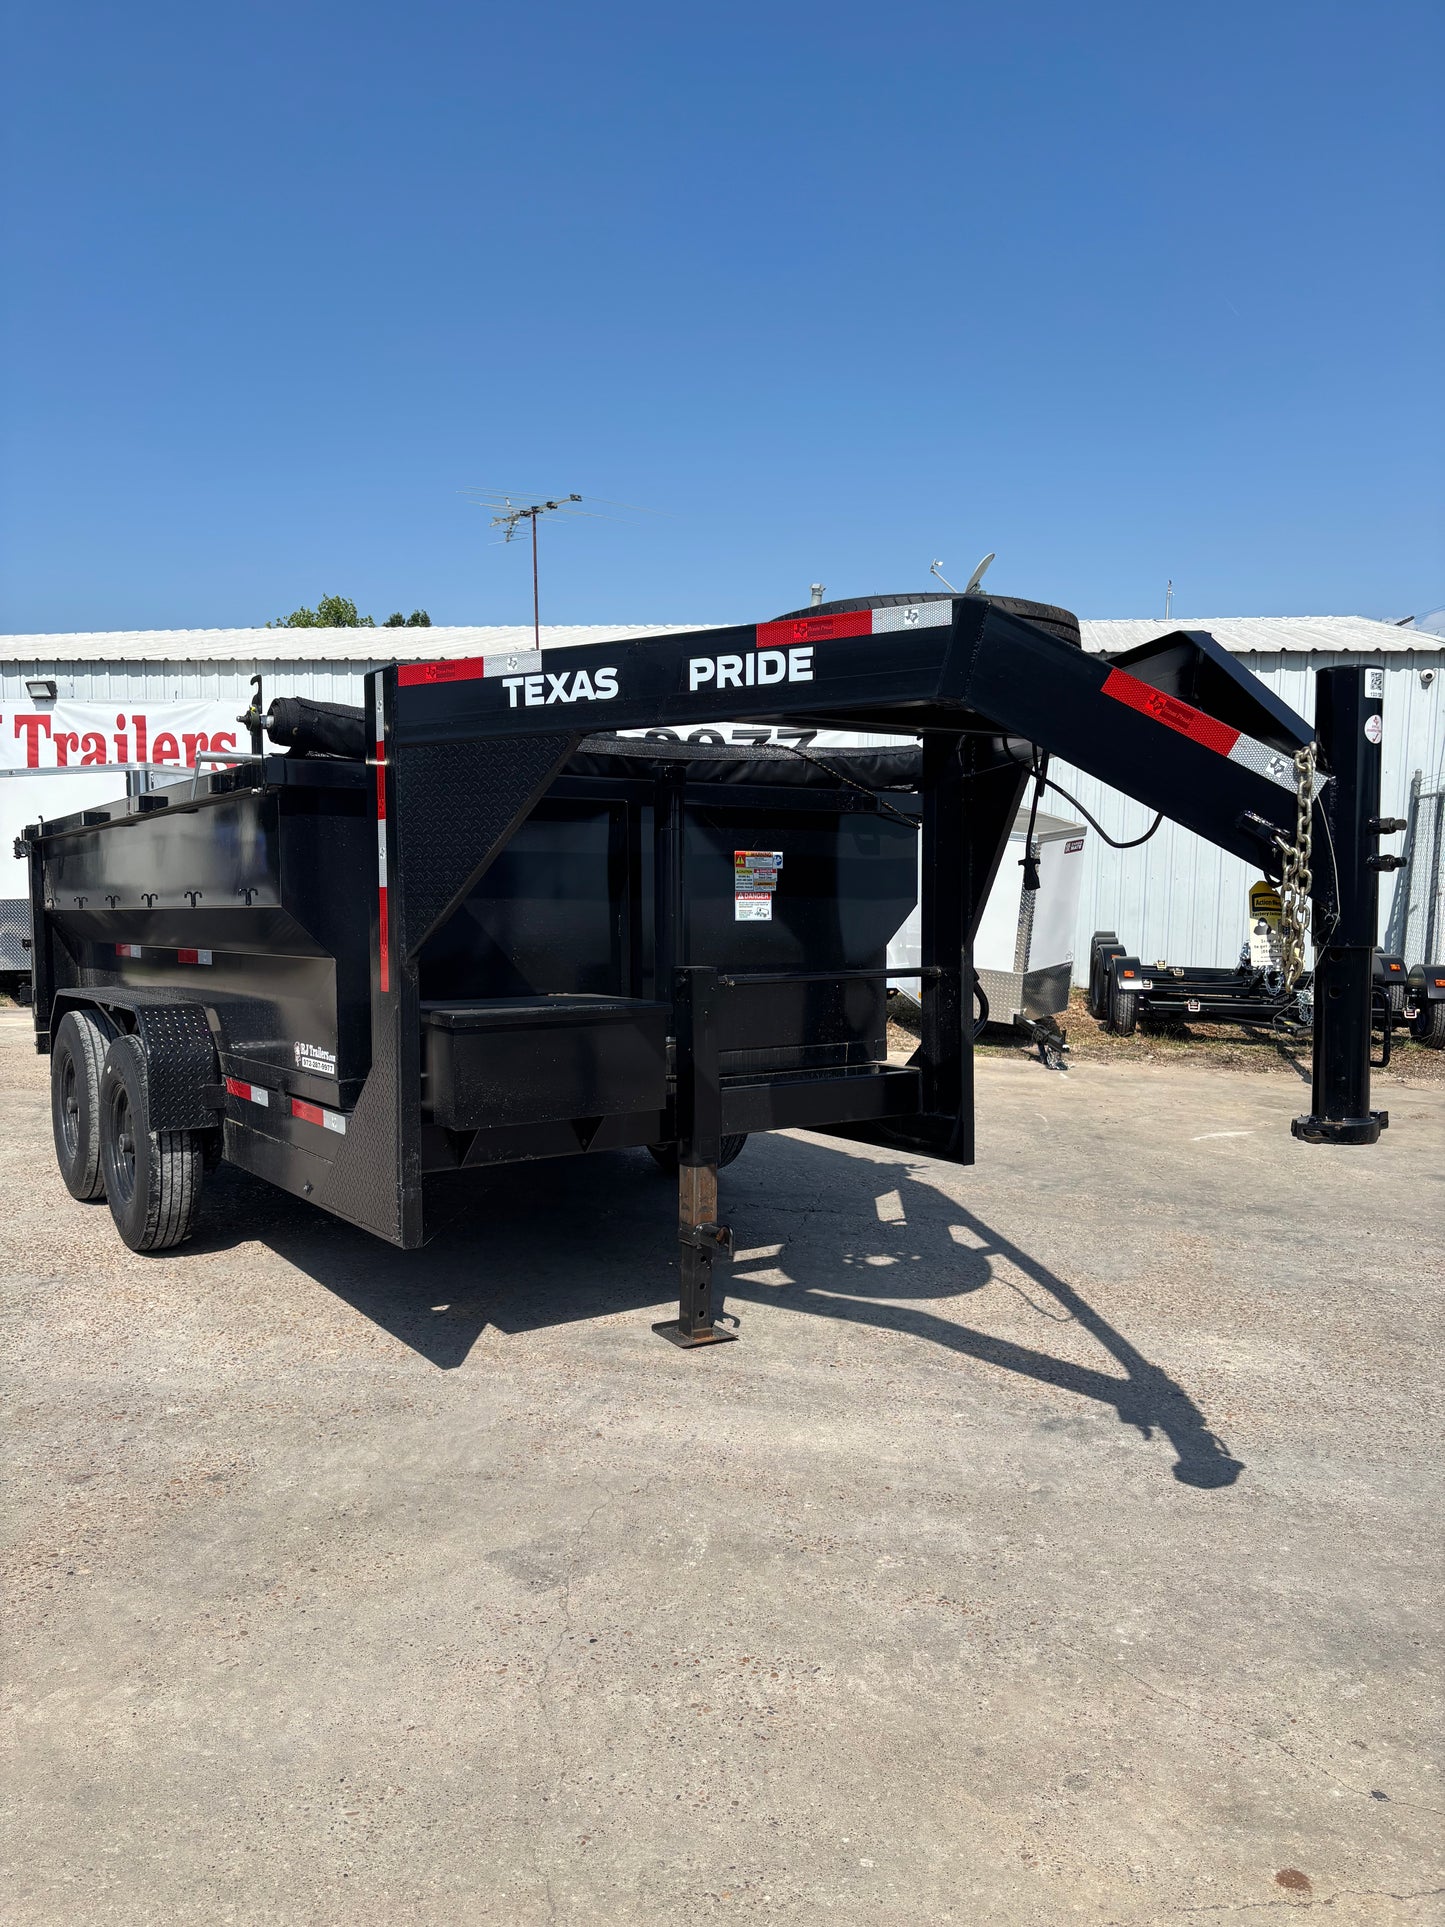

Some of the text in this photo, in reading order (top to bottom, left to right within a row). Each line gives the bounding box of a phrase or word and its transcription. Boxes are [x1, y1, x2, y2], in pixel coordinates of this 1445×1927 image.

[502, 646, 814, 708] TEXAS PRIDE
[14, 713, 237, 772] Trailers
